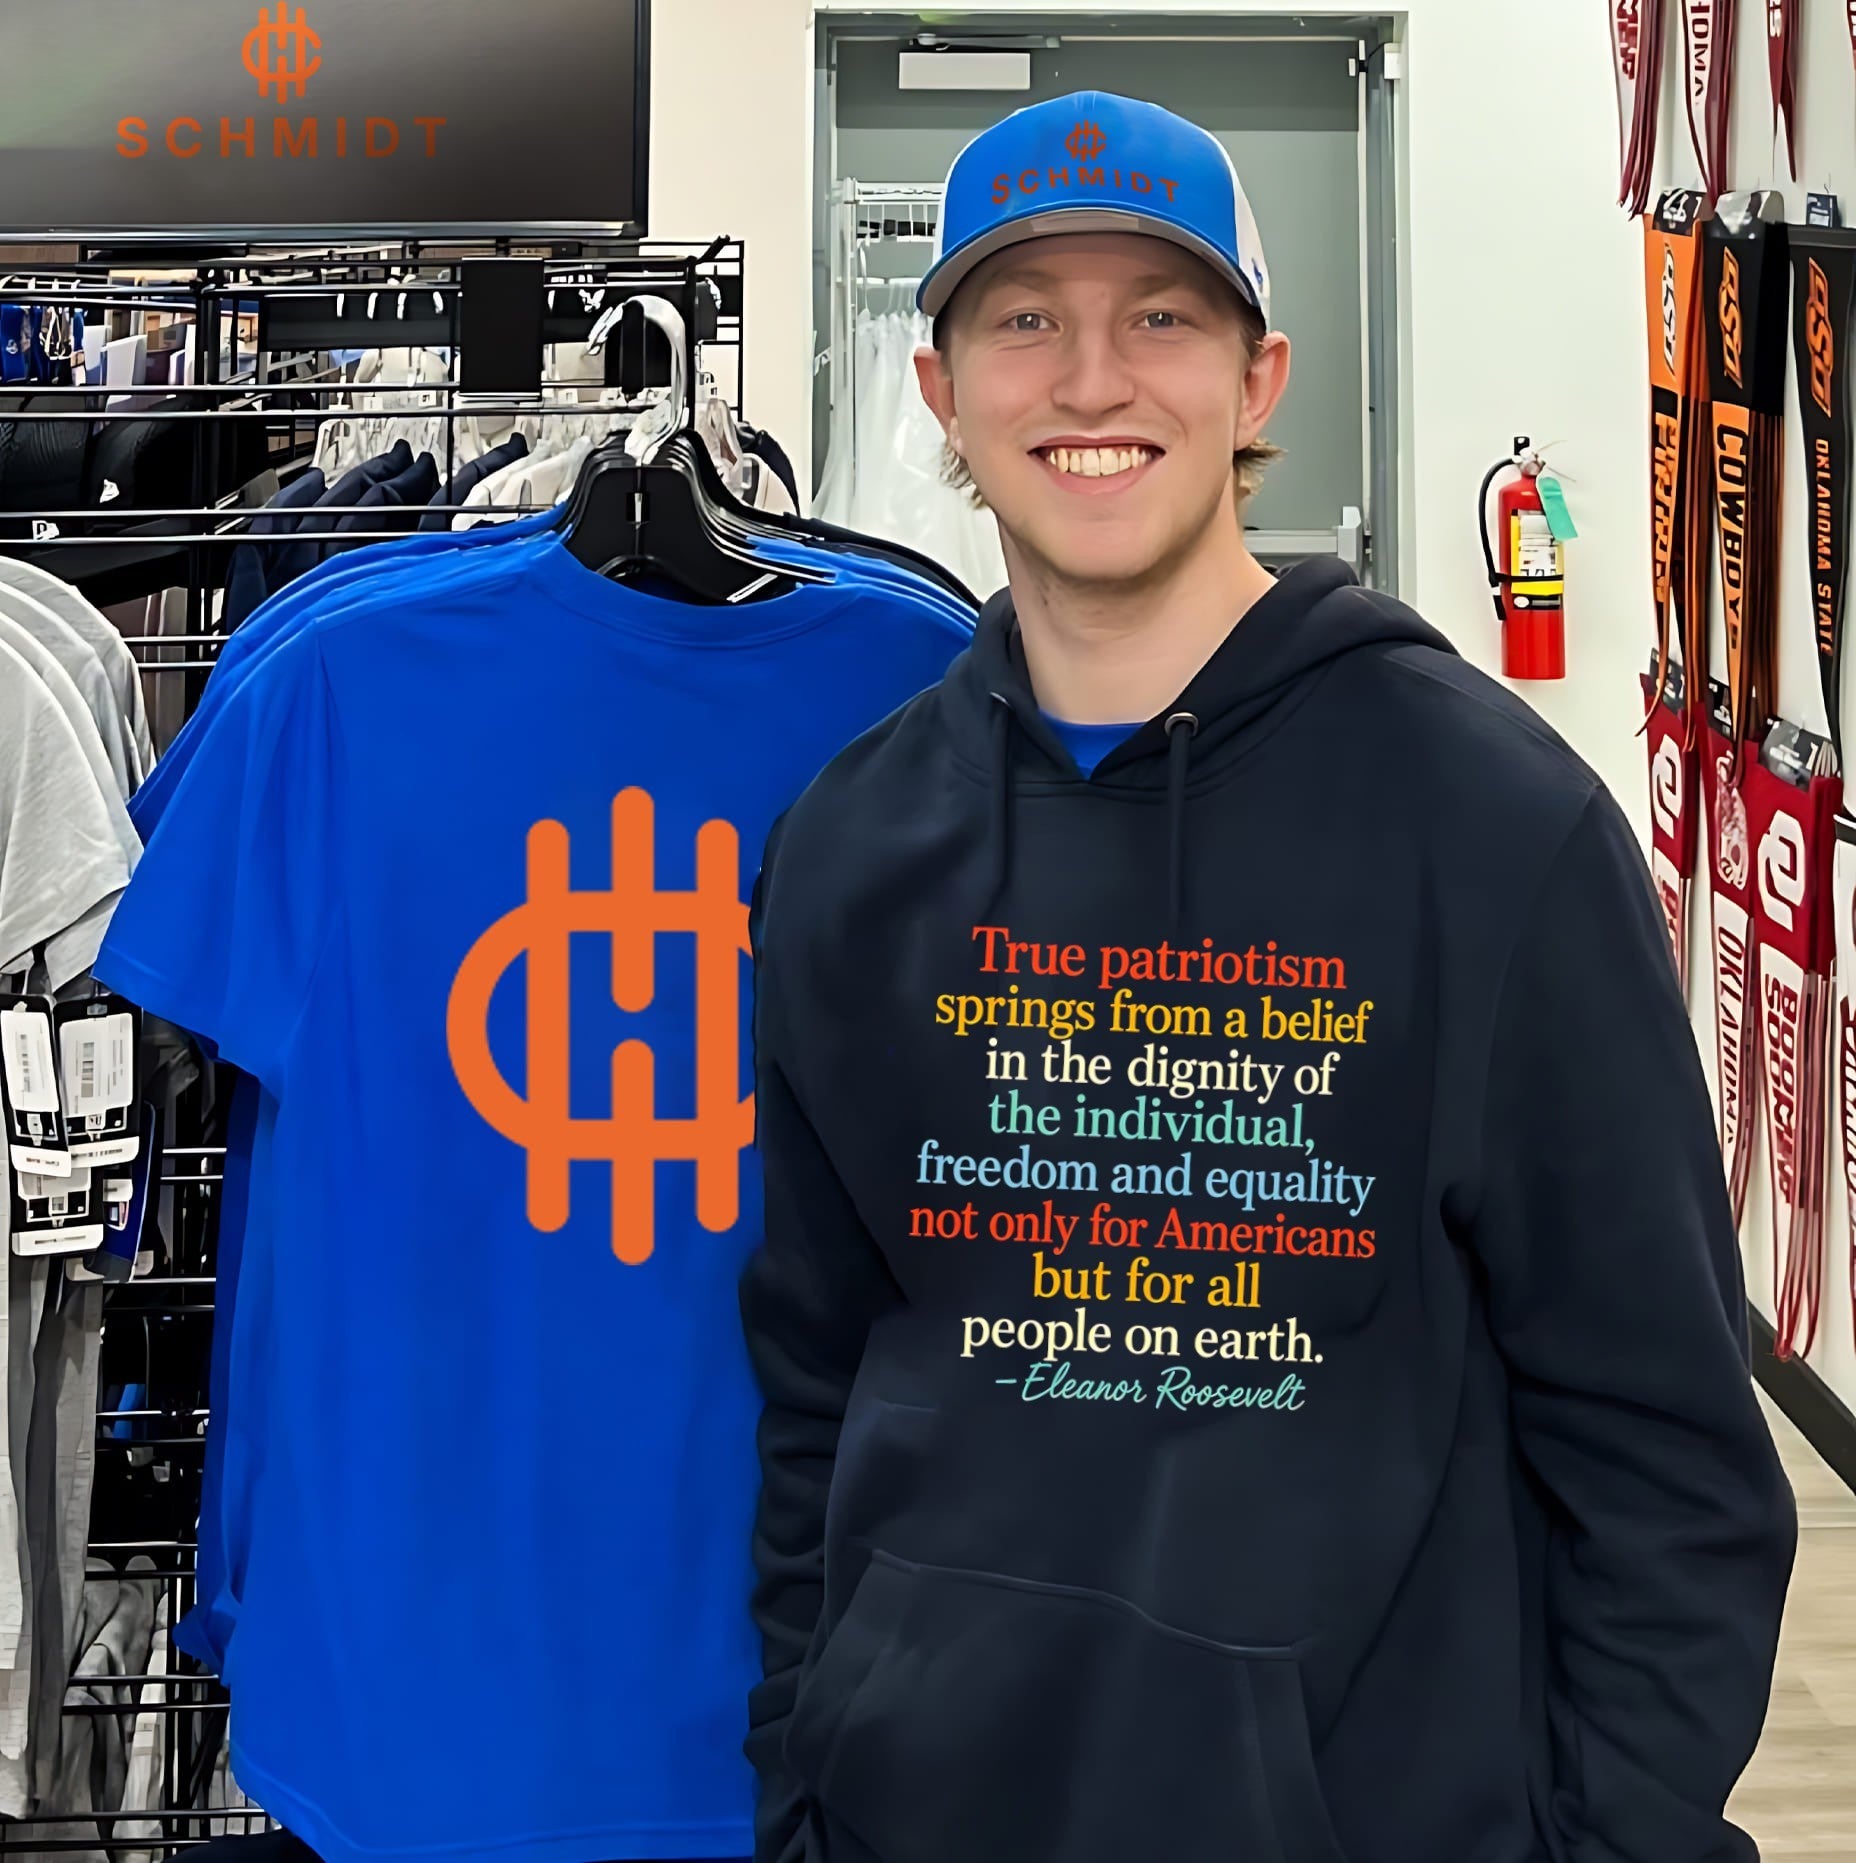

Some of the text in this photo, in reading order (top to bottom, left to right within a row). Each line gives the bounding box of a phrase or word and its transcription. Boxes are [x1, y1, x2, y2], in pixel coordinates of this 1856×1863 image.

[115, 116, 448, 159] SCHMIDT
[991, 166, 1180, 205] SCHMIDT
[1814, 438, 1833, 570] OKLAHOMA
[972, 927, 1346, 989] True patriotism
[936, 985, 1373, 1043] springs from a belief
[1717, 927, 1746, 1144] OKLAHOMA
[986, 1038, 1340, 1104] in the dignity of
[988, 1089, 1314, 1155] the individual,
[917, 1139, 1375, 1216] freedom and equality
[910, 1200, 1375, 1258] not only for Americans
[1033, 1252, 1260, 1307] but for all
[960, 1307, 1323, 1363] people on earth.
[1156, 1366, 1305, 1411] Roosevelt
